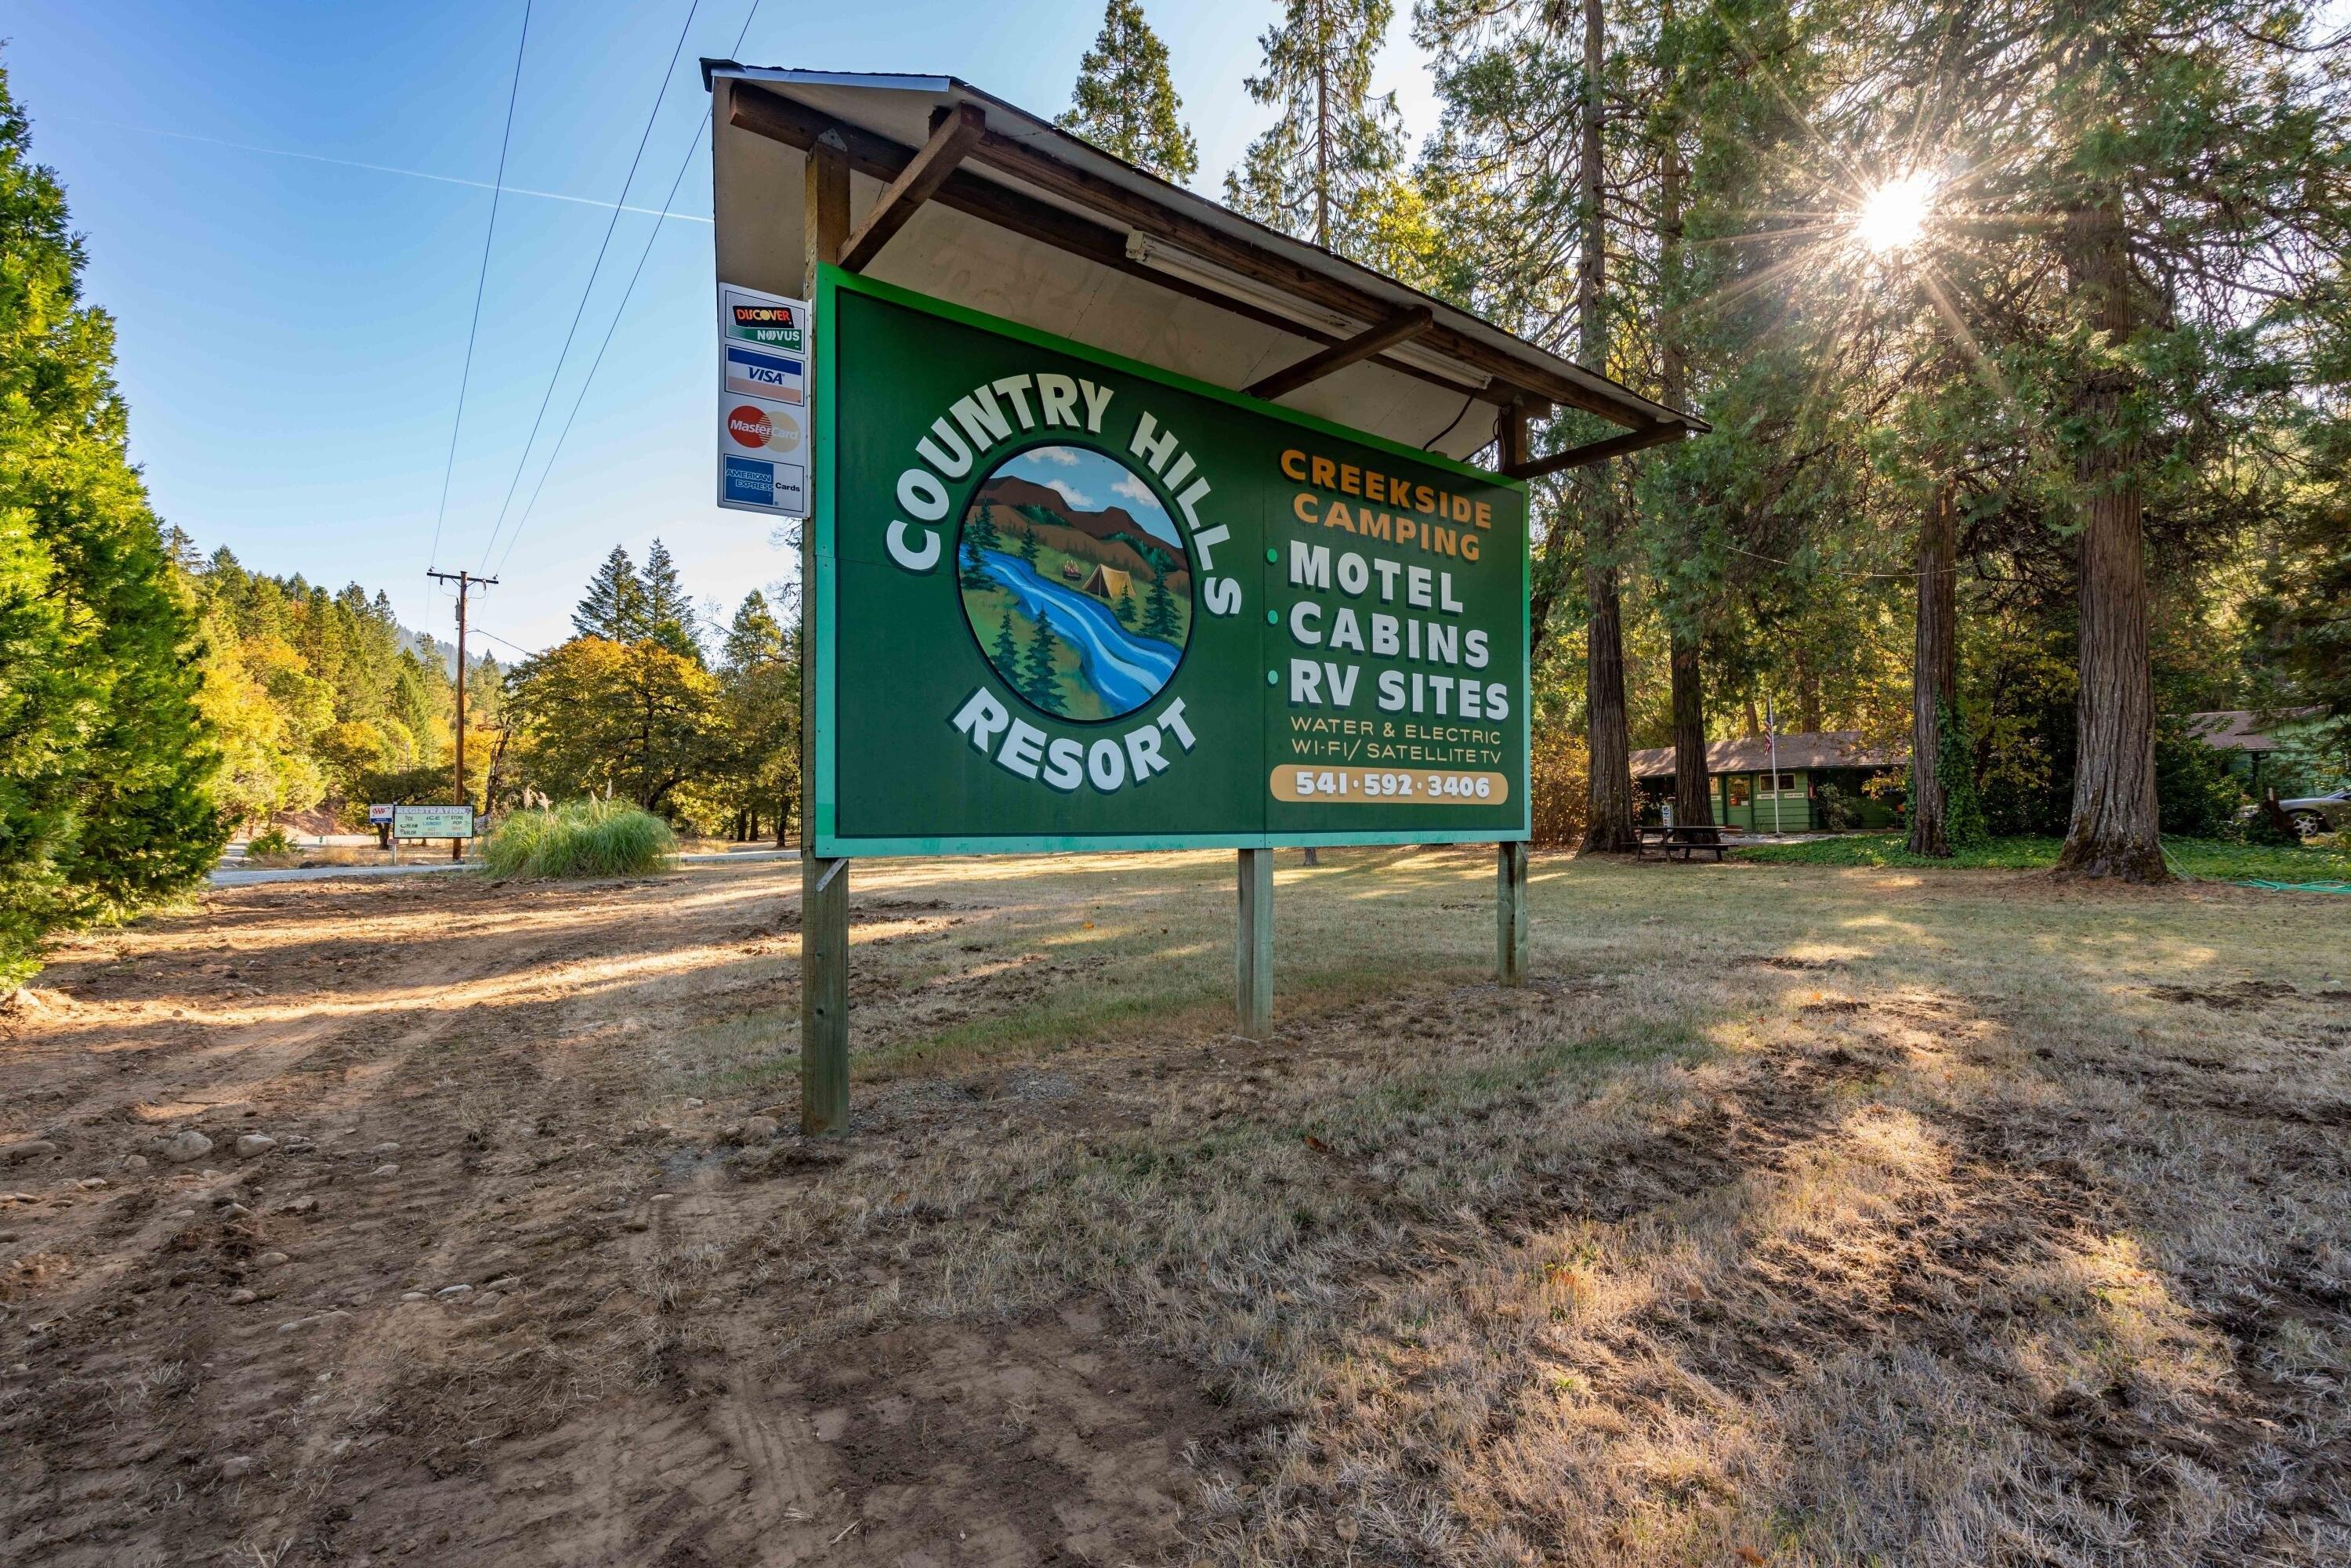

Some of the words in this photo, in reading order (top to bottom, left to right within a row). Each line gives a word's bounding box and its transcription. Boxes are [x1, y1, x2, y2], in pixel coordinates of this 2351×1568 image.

[737, 309, 790, 321] DISCOVER
[757, 330, 800, 342] NOVUS
[748, 367, 783, 385] VISA
[730, 419, 799, 440] MasterCard
[726, 468, 772, 483] AMERICAN
[735, 479, 774, 491] EXPRESS
[775, 482, 801, 492] Cards
[886, 373, 1114, 571] COUNTRY
[1129, 411, 1242, 616] HILLS
[1281, 449, 1492, 530] CREEKSIDE
[1294, 492, 1480, 561] CAMPING
[1290, 539, 1463, 613] MOTEL
[1290, 601, 1489, 668] CABINS
[1291, 658, 1360, 706] RV
[1378, 670, 1509, 721] SITES
[952, 686, 1197, 791] RESORT
[1291, 716, 1374, 736] WATER
[1383, 722, 1395, 737] &
[1405, 725, 1501, 744] ELECTRIC
